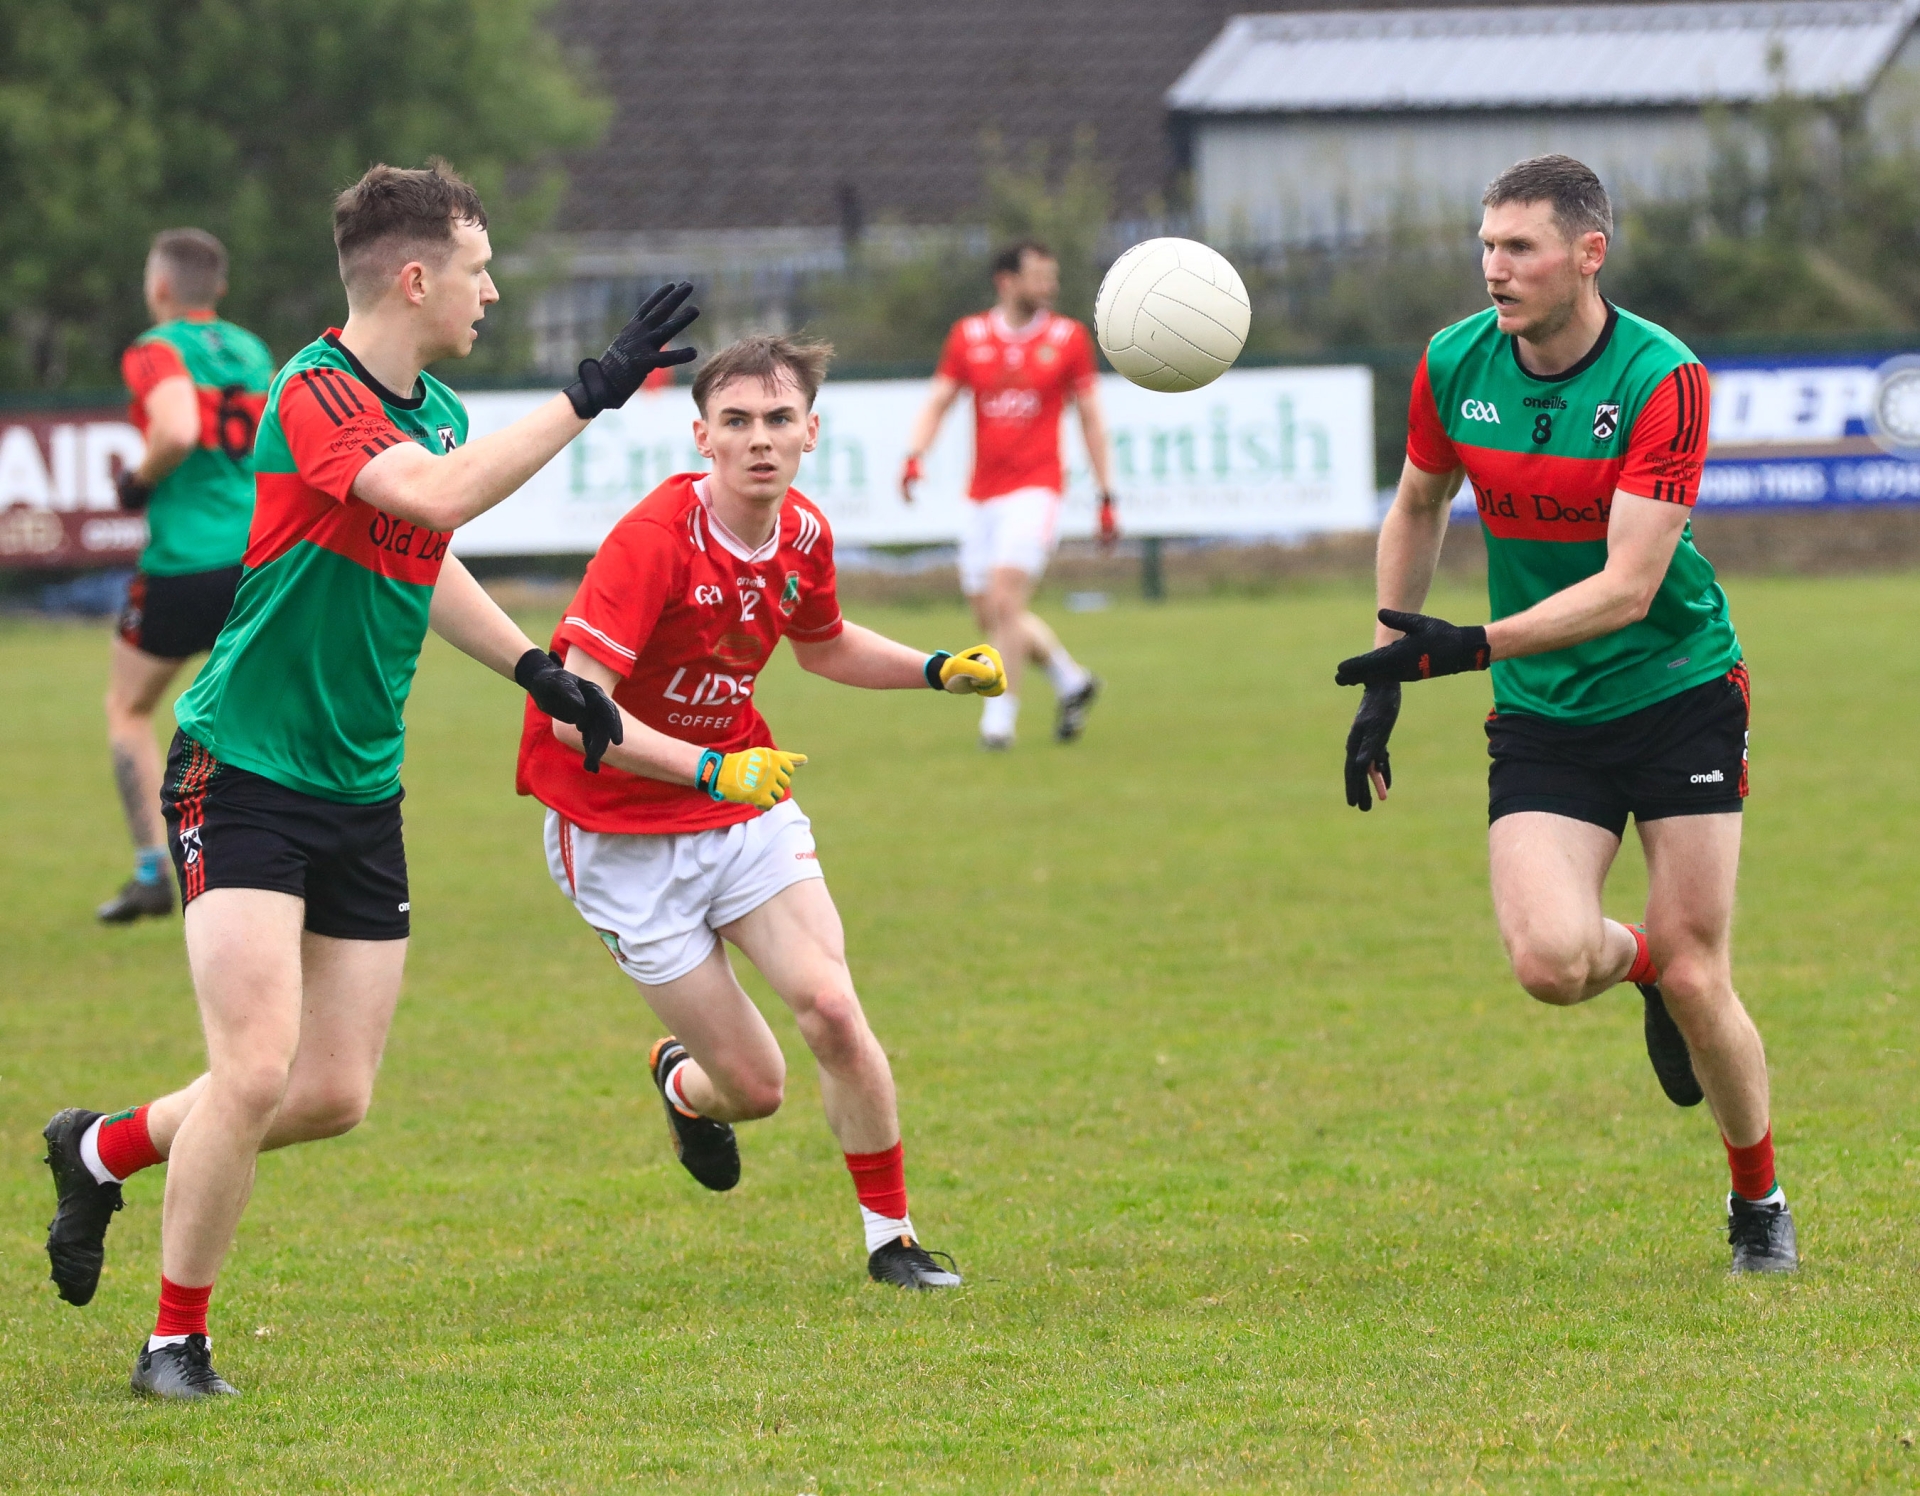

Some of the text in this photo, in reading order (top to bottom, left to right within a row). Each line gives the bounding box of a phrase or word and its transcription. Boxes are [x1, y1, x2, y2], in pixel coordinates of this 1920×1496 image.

[218, 383, 254, 460] 6
[1461, 398, 1501, 425] GAA
[1531, 413, 1552, 445] 8
[1530, 494, 1611, 523] Dock
[369, 511, 416, 556] Old
[739, 590, 760, 622] 12
[662, 667, 754, 706] LIDS
